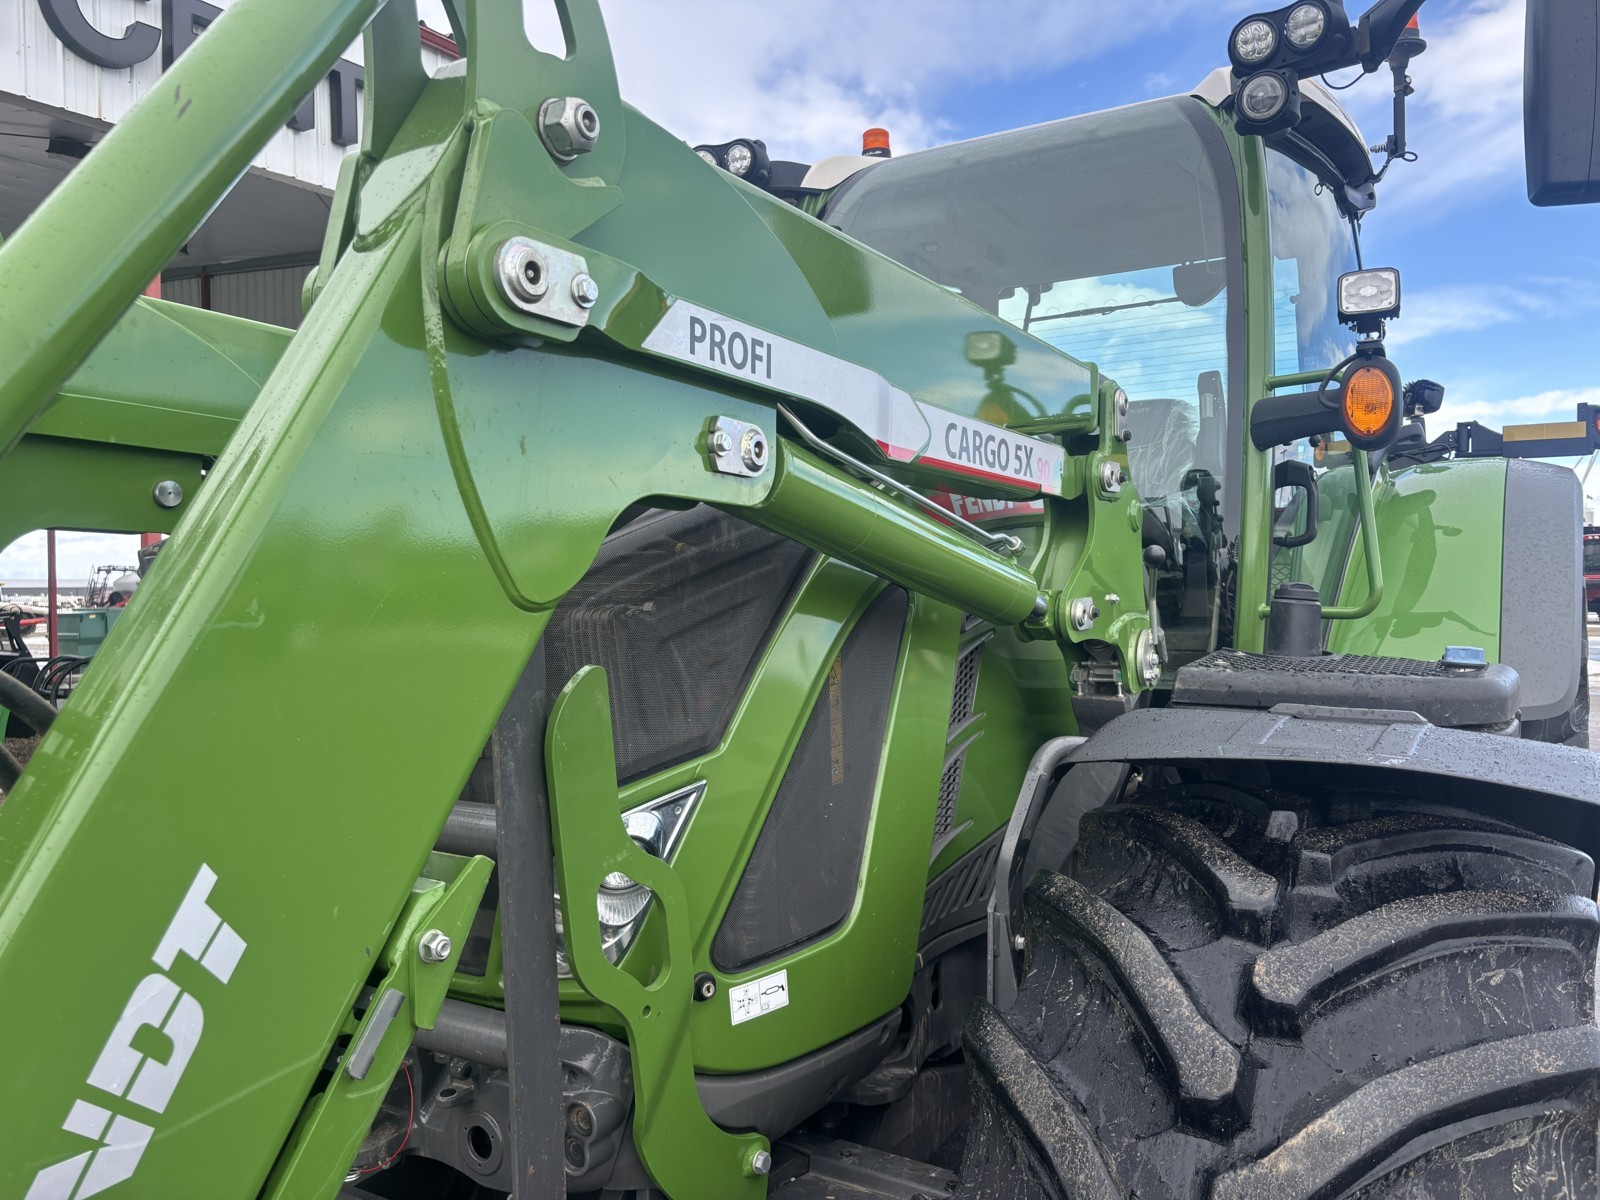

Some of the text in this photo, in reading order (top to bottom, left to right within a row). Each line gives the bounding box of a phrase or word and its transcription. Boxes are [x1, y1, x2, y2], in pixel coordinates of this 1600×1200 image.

[690, 316, 771, 379] PROFI
[945, 422, 1051, 480] CARGO 5X 90
